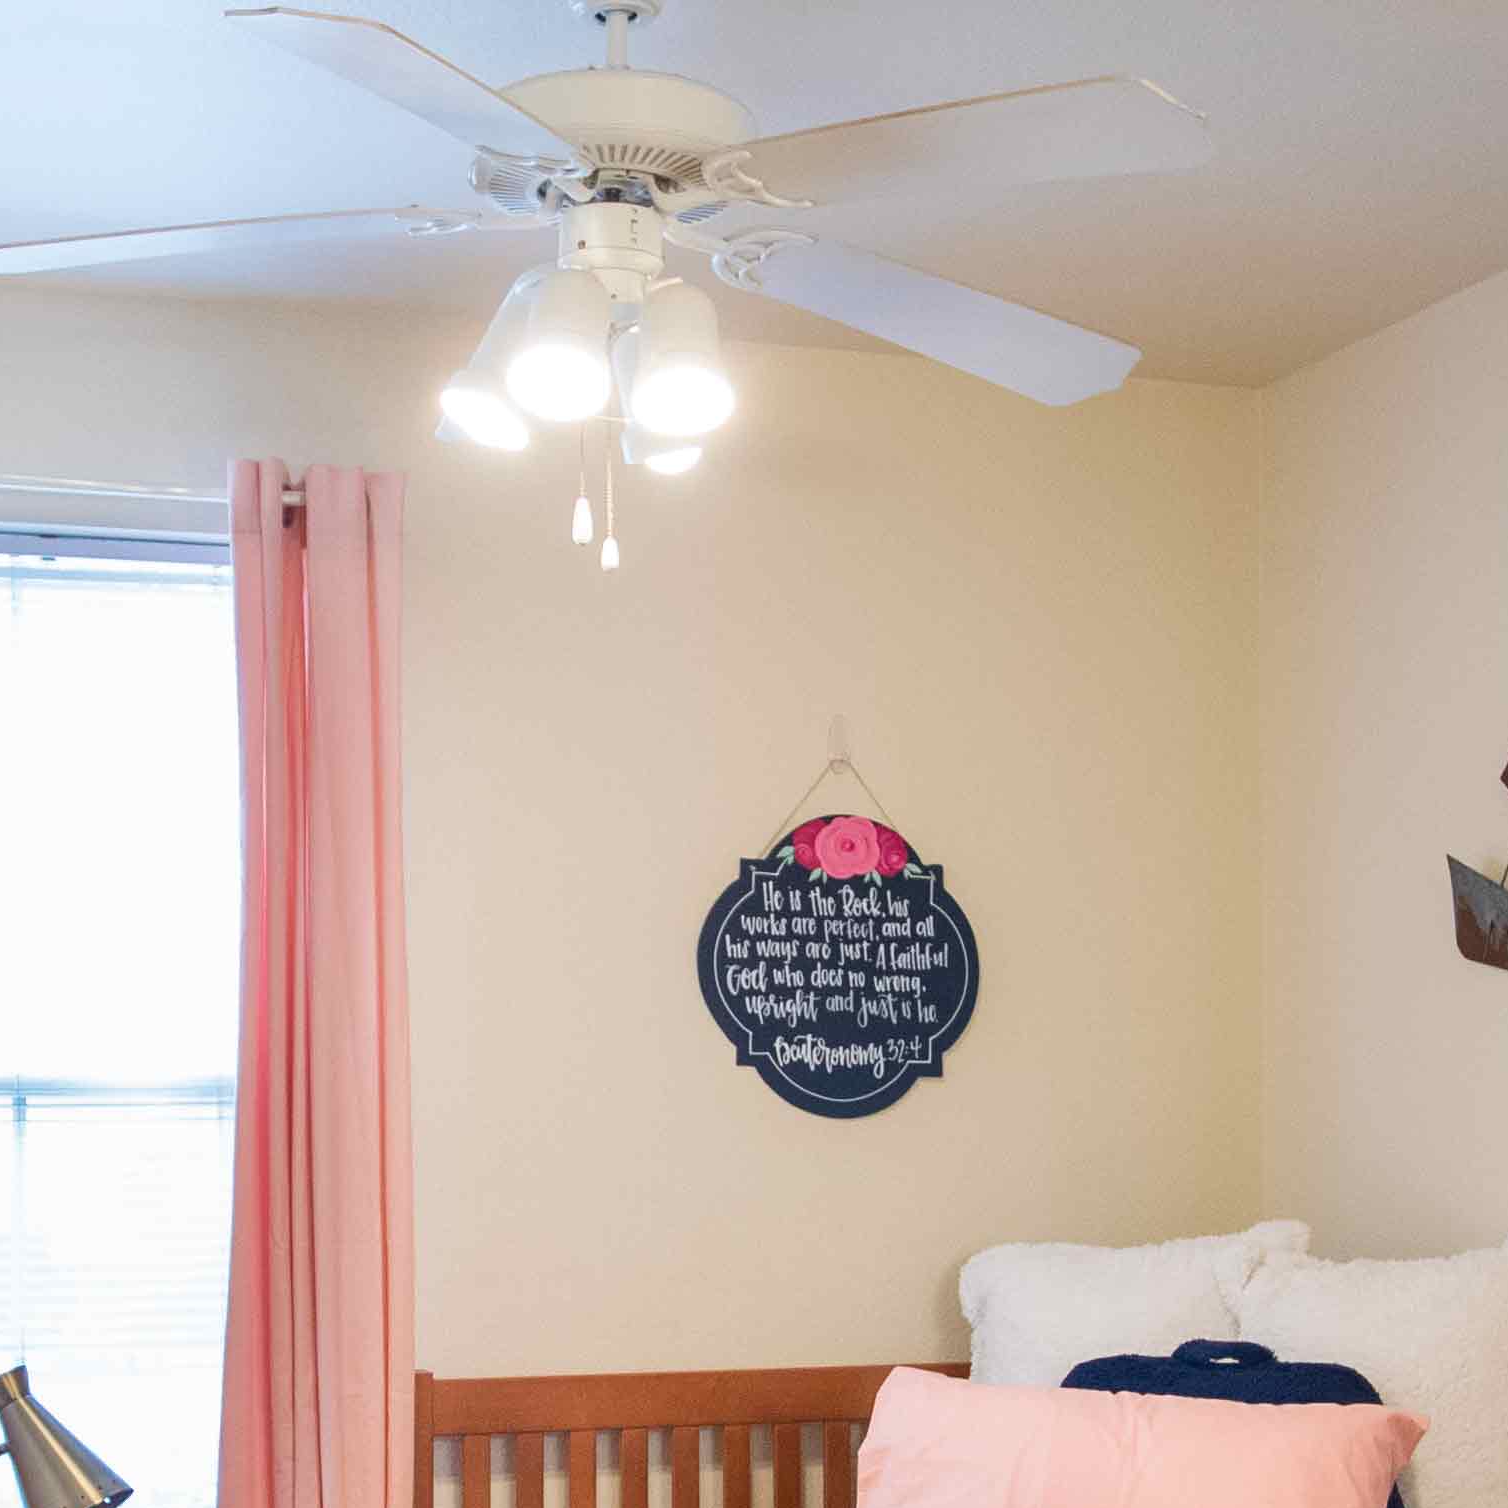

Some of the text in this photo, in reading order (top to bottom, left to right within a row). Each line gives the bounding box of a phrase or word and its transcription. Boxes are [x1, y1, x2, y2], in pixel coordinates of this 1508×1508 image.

[763, 881, 784, 911] He
[788, 886, 801, 911] is
[809, 886, 836, 916] the
[887, 889, 910, 917] his
[741, 913, 787, 935] works
[792, 917, 817, 935] are
[882, 918, 911, 938] and
[916, 915, 935, 937] all
[725, 933, 750, 959] his
[756, 938, 800, 964] ways
[805, 942, 831, 960] are
[876, 943, 887, 970] A
[890, 942, 949, 971] faithful
[725, 960, 768, 995] God
[773, 964, 805, 987] who
[810, 961, 844, 988] does
[848, 970, 866, 988] no
[745, 990, 821, 1028] upright
[826, 992, 854, 1013] and
[857, 992, 899, 1028] just
[901, 998, 912, 1019] is
[773, 1033, 922, 1079] Deuteronomy 32:4
